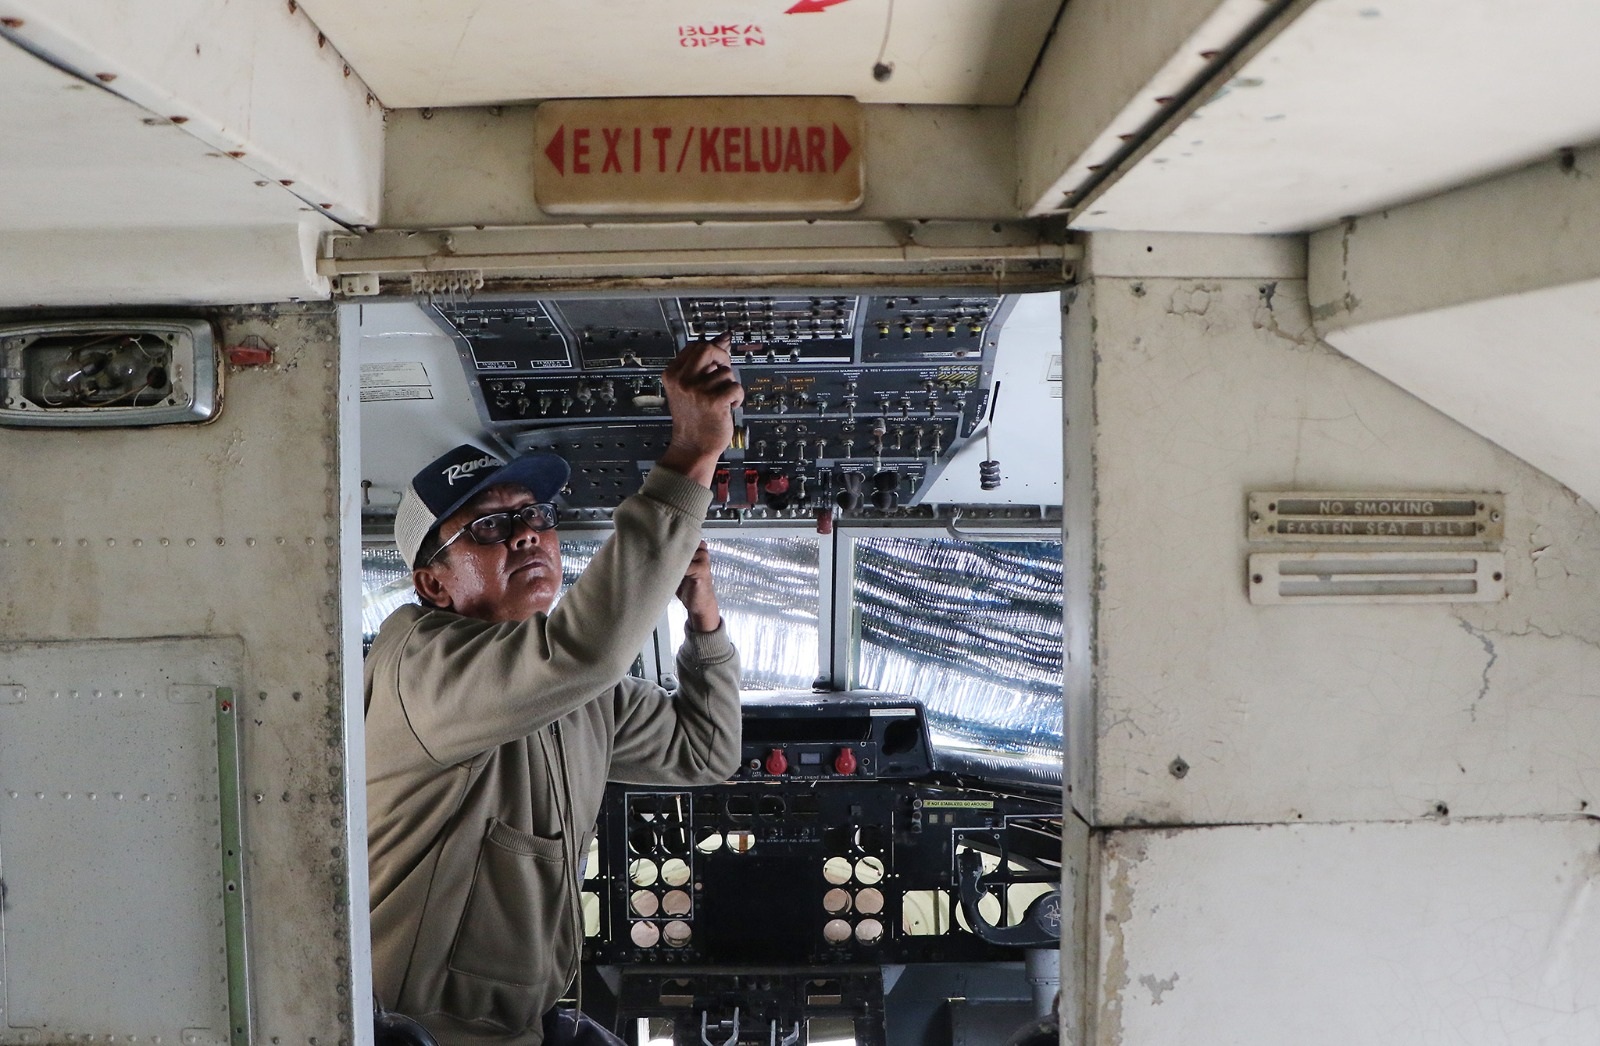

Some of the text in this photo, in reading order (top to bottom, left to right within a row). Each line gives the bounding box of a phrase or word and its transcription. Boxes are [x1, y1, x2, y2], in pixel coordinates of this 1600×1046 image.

[678, 25, 763, 36] BUKA
[679, 37, 766, 48] OPEN
[572, 126, 827, 175] EXIT/KELUAR
[1319, 501, 1435, 515] NO SMOKING
[1286, 522, 1468, 535] FASTEN SEAT BELT
